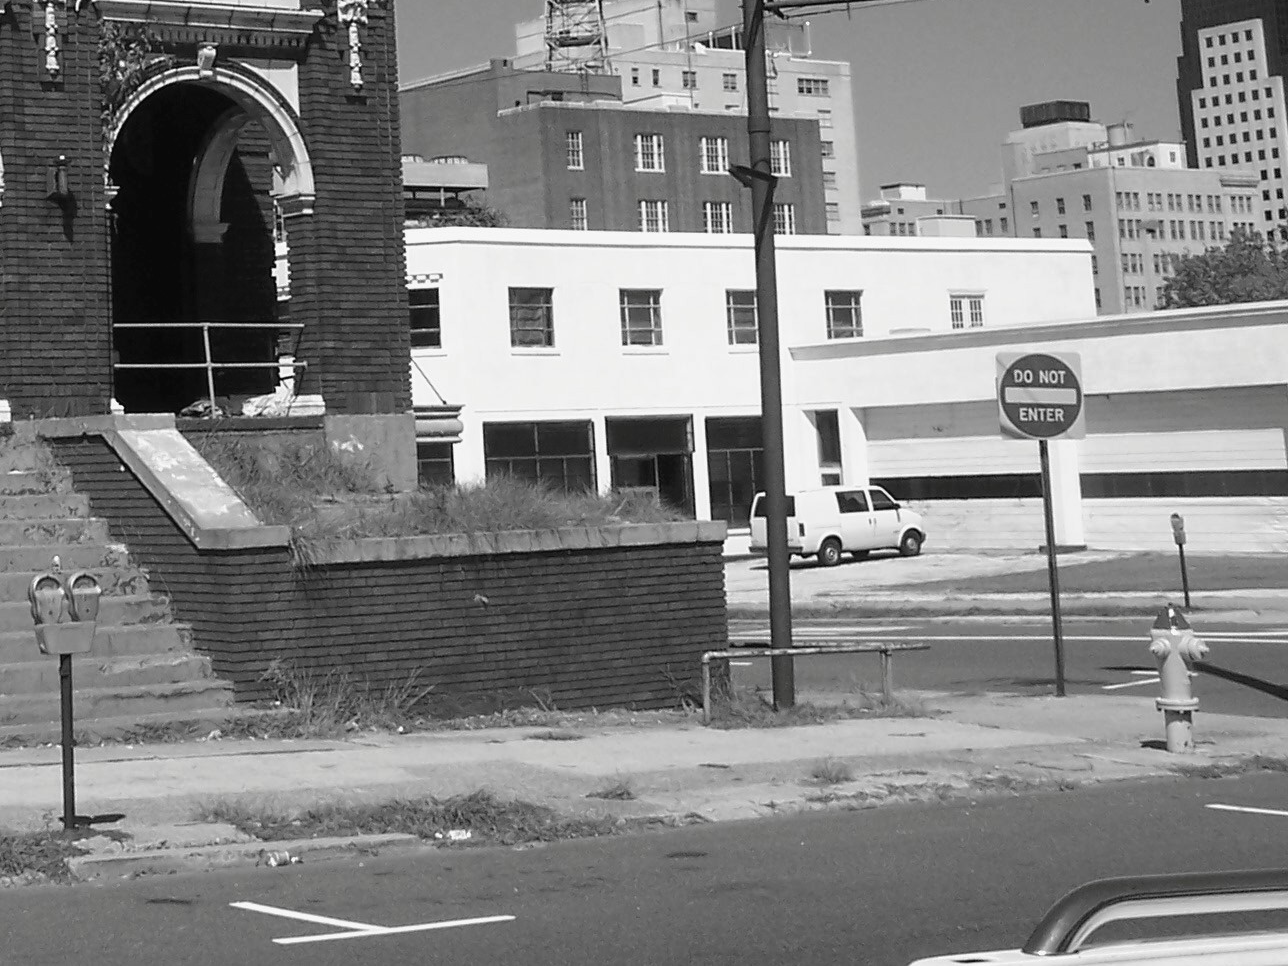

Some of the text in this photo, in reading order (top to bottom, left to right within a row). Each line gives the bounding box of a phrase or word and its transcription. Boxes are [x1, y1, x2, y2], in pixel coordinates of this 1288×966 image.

[1014, 369, 1066, 384] DO NOT
[1019, 407, 1064, 422] ENTER
